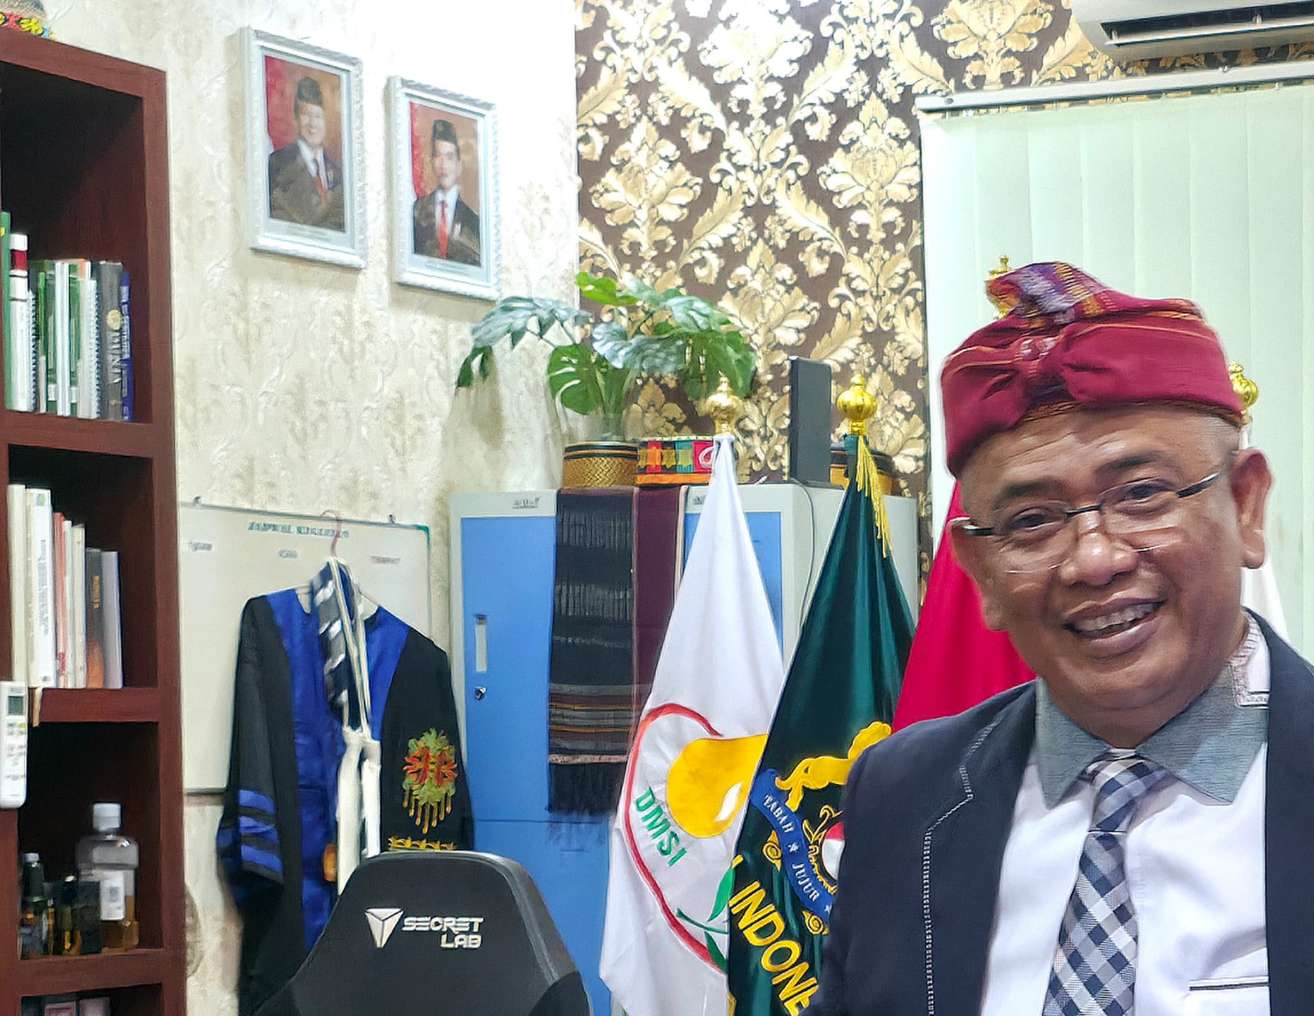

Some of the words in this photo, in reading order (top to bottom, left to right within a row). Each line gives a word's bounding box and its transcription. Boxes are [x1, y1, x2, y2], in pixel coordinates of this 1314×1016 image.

[636, 787, 688, 867] DMSI
[763, 793, 796, 834] TABAH
[791, 862, 820, 902] JUJUR
[401, 916, 484, 934] SECRET
[440, 933, 482, 949] LAB
